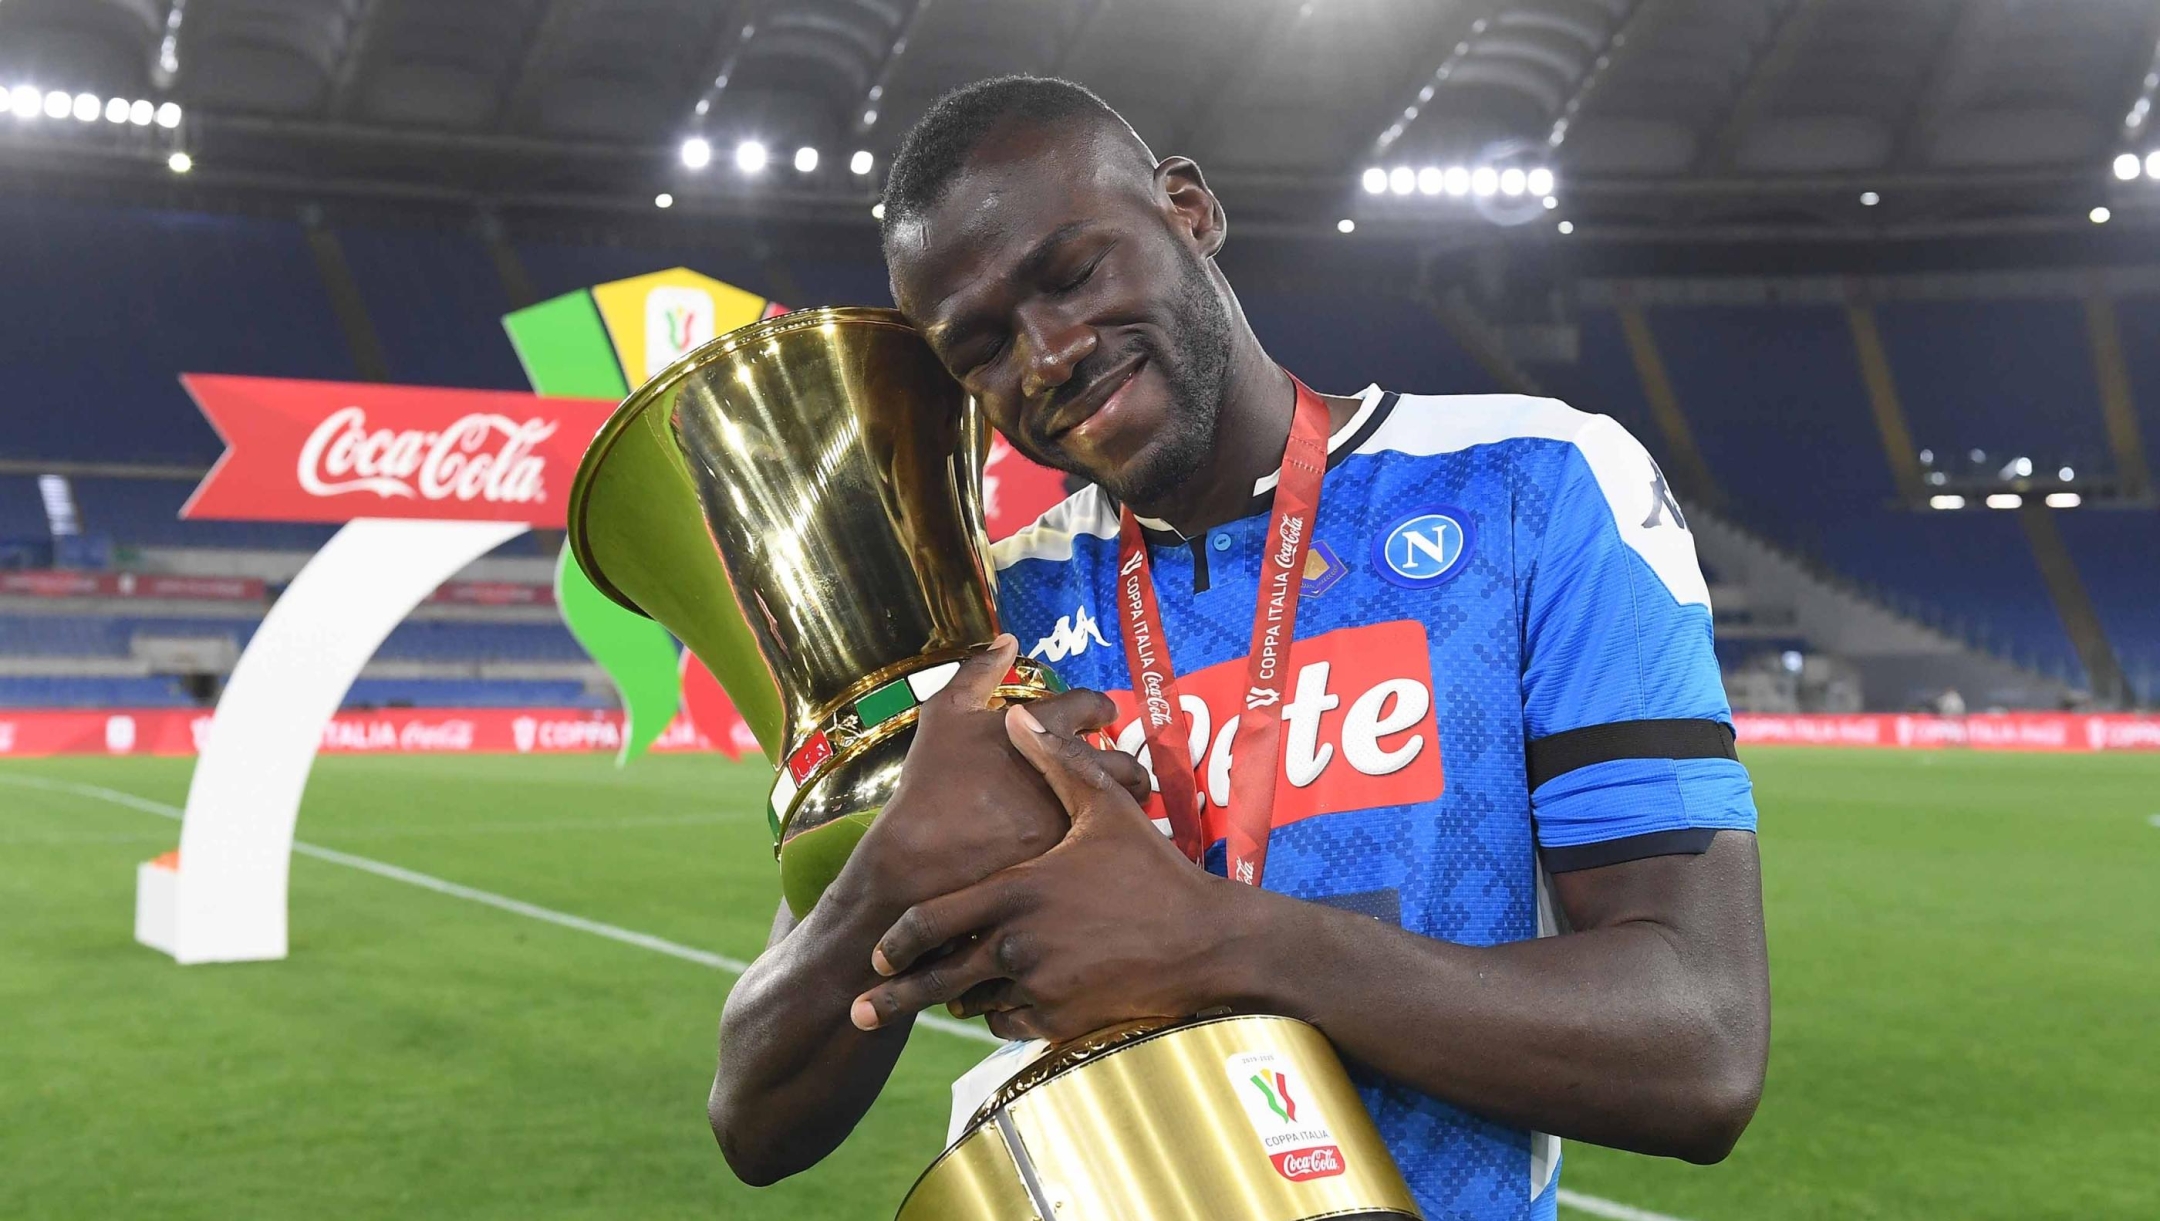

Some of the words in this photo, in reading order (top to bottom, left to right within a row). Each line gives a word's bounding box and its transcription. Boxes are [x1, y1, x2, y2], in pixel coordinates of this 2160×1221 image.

[297, 406, 559, 503] Coca-Cola
[1274, 513, 1304, 568] Coca-Cola
[1402, 525, 1447, 568] N
[1127, 575, 1143, 621] COPPA
[1268, 572, 1290, 622] ITALIA
[1133, 619, 1156, 669] ITALIA
[1260, 624, 1281, 679] COPPA
[1142, 671, 1172, 729] Coca-Cola
[1265, 1132, 1300, 1147] COPPA
[1300, 1130, 1330, 1141] ITALIA
[1284, 1149, 1339, 1177] Coca-Cola
